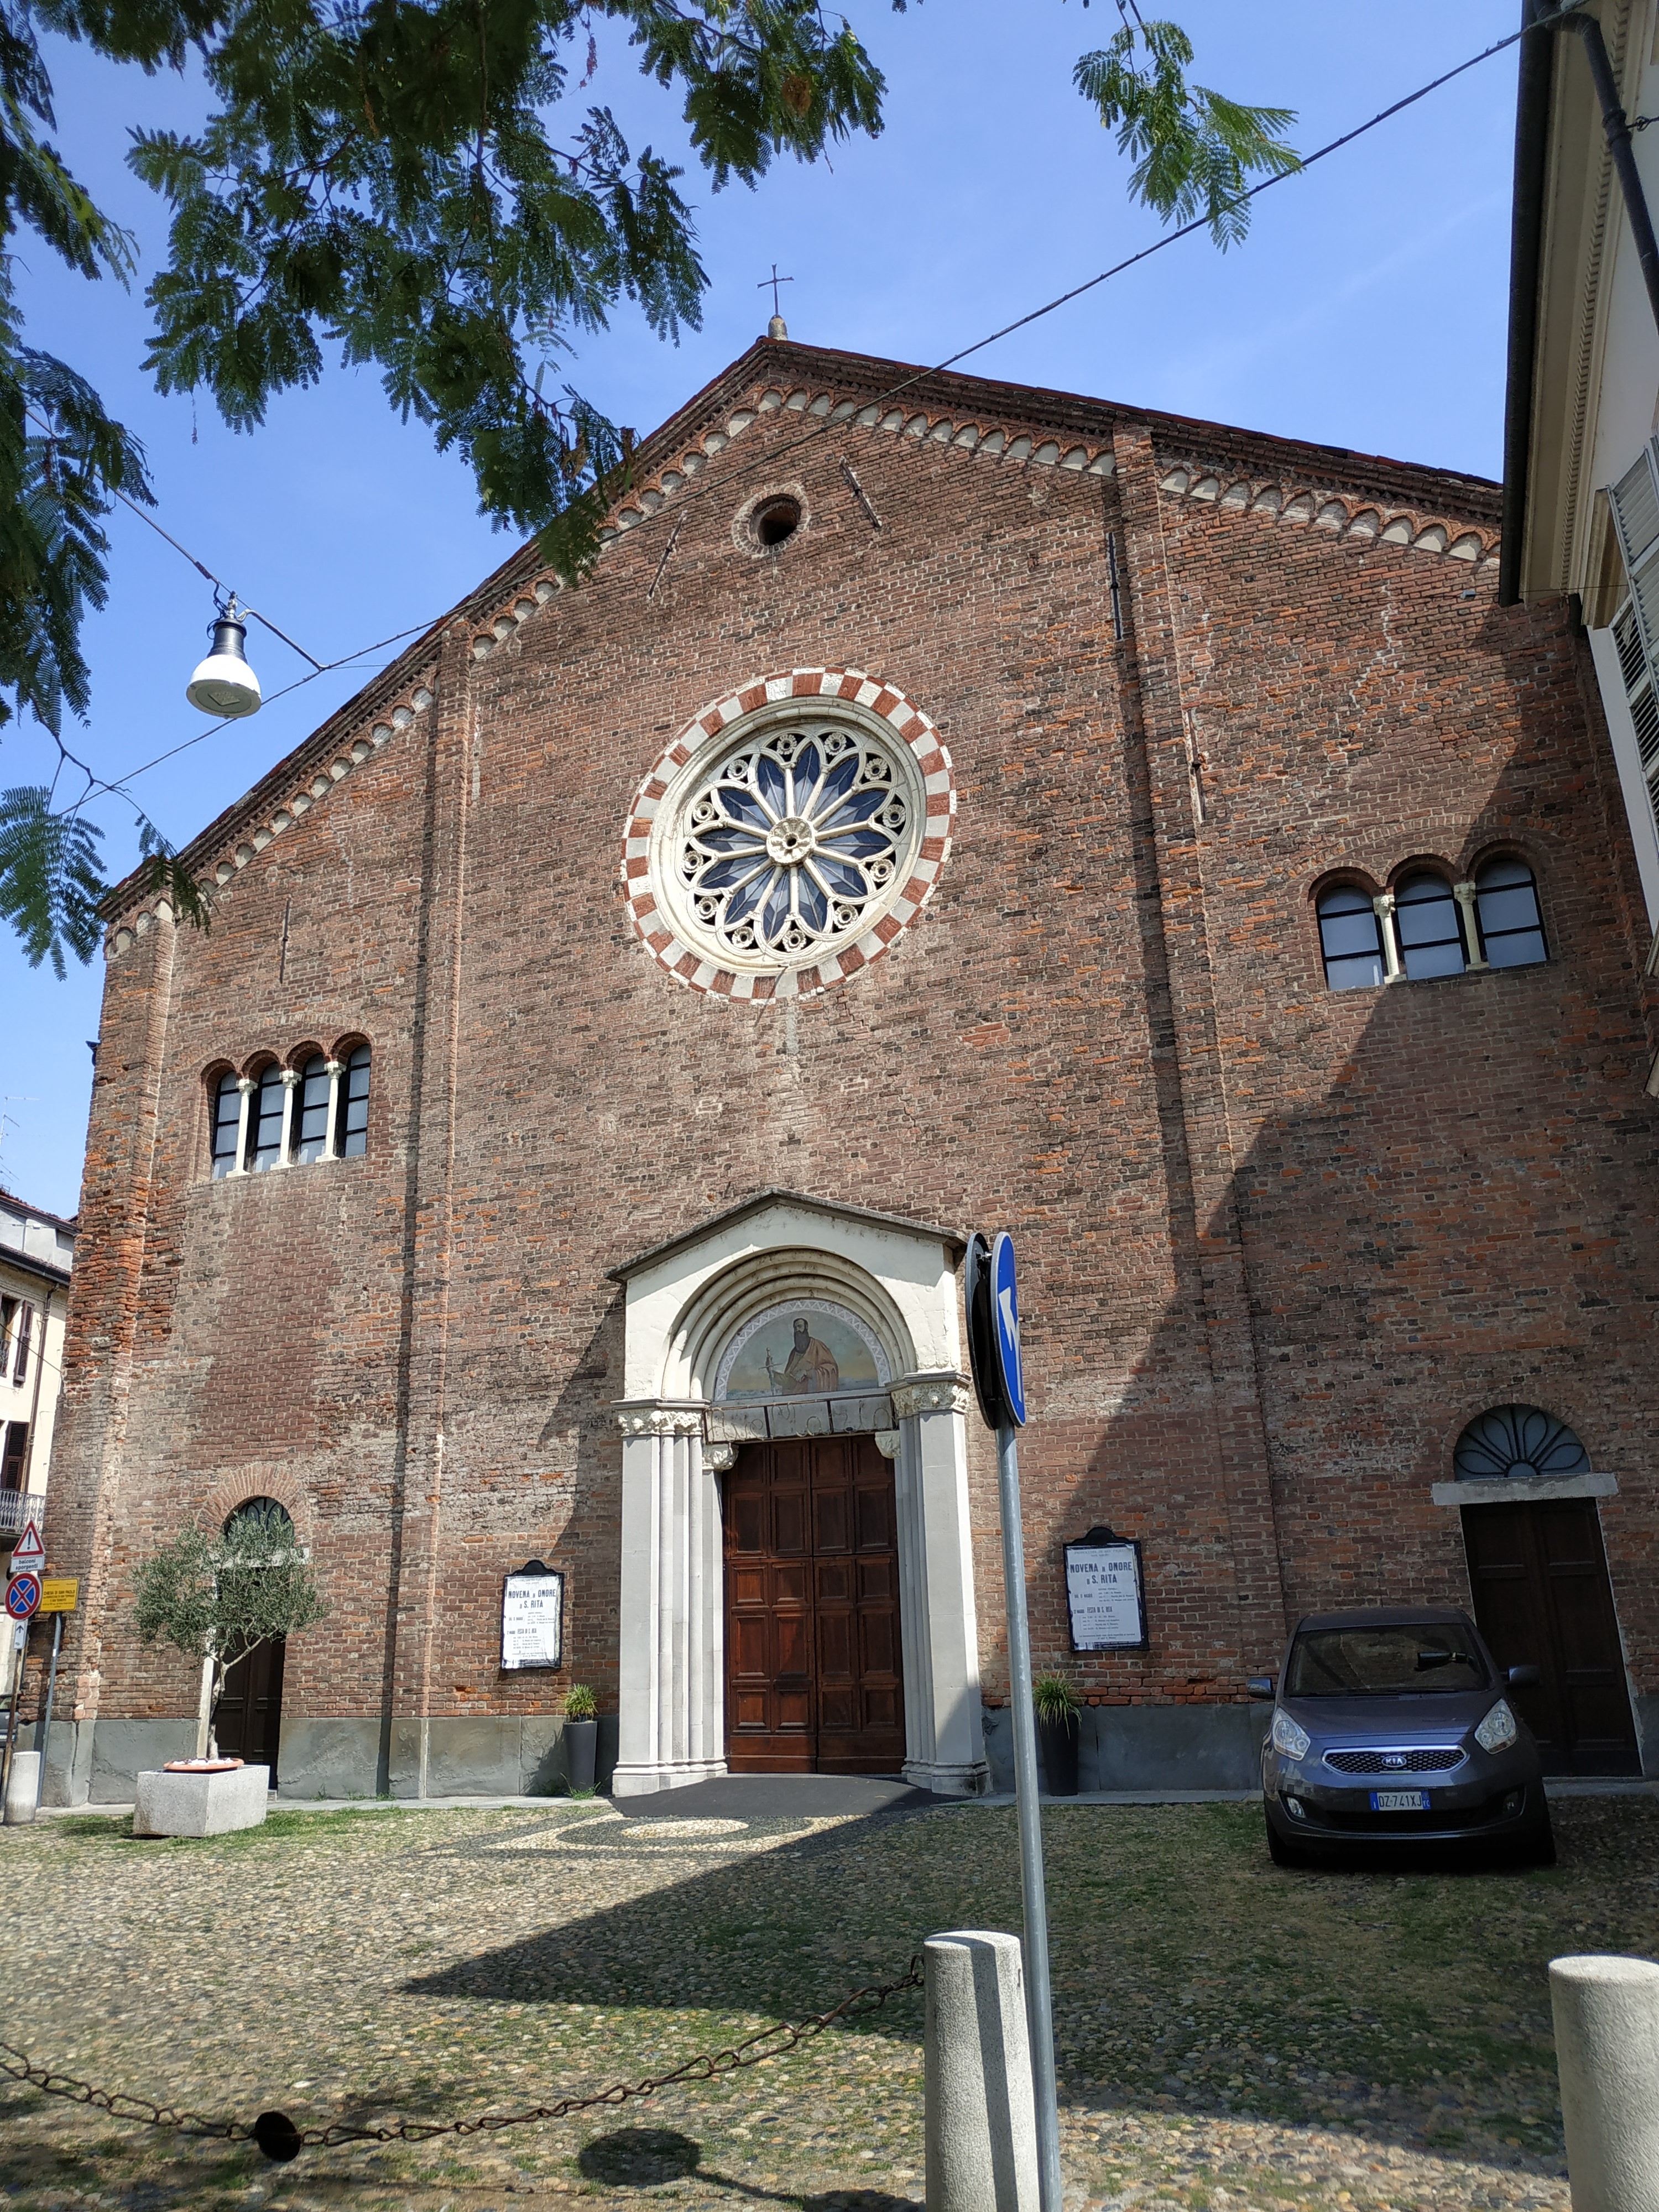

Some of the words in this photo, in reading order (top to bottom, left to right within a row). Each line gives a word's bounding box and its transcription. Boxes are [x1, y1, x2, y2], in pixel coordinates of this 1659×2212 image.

[1070, 1563, 1099, 1573] NOVENA
[1108, 1561, 1133, 1571] ONORE
[1092, 1575, 1098, 1584] S.
[1100, 1574, 1117, 1583] RITA
[508, 1590, 530, 1599] NOVENA
[538, 1589, 556, 1598] ONORE
[531, 1600, 543, 1608] RITA
